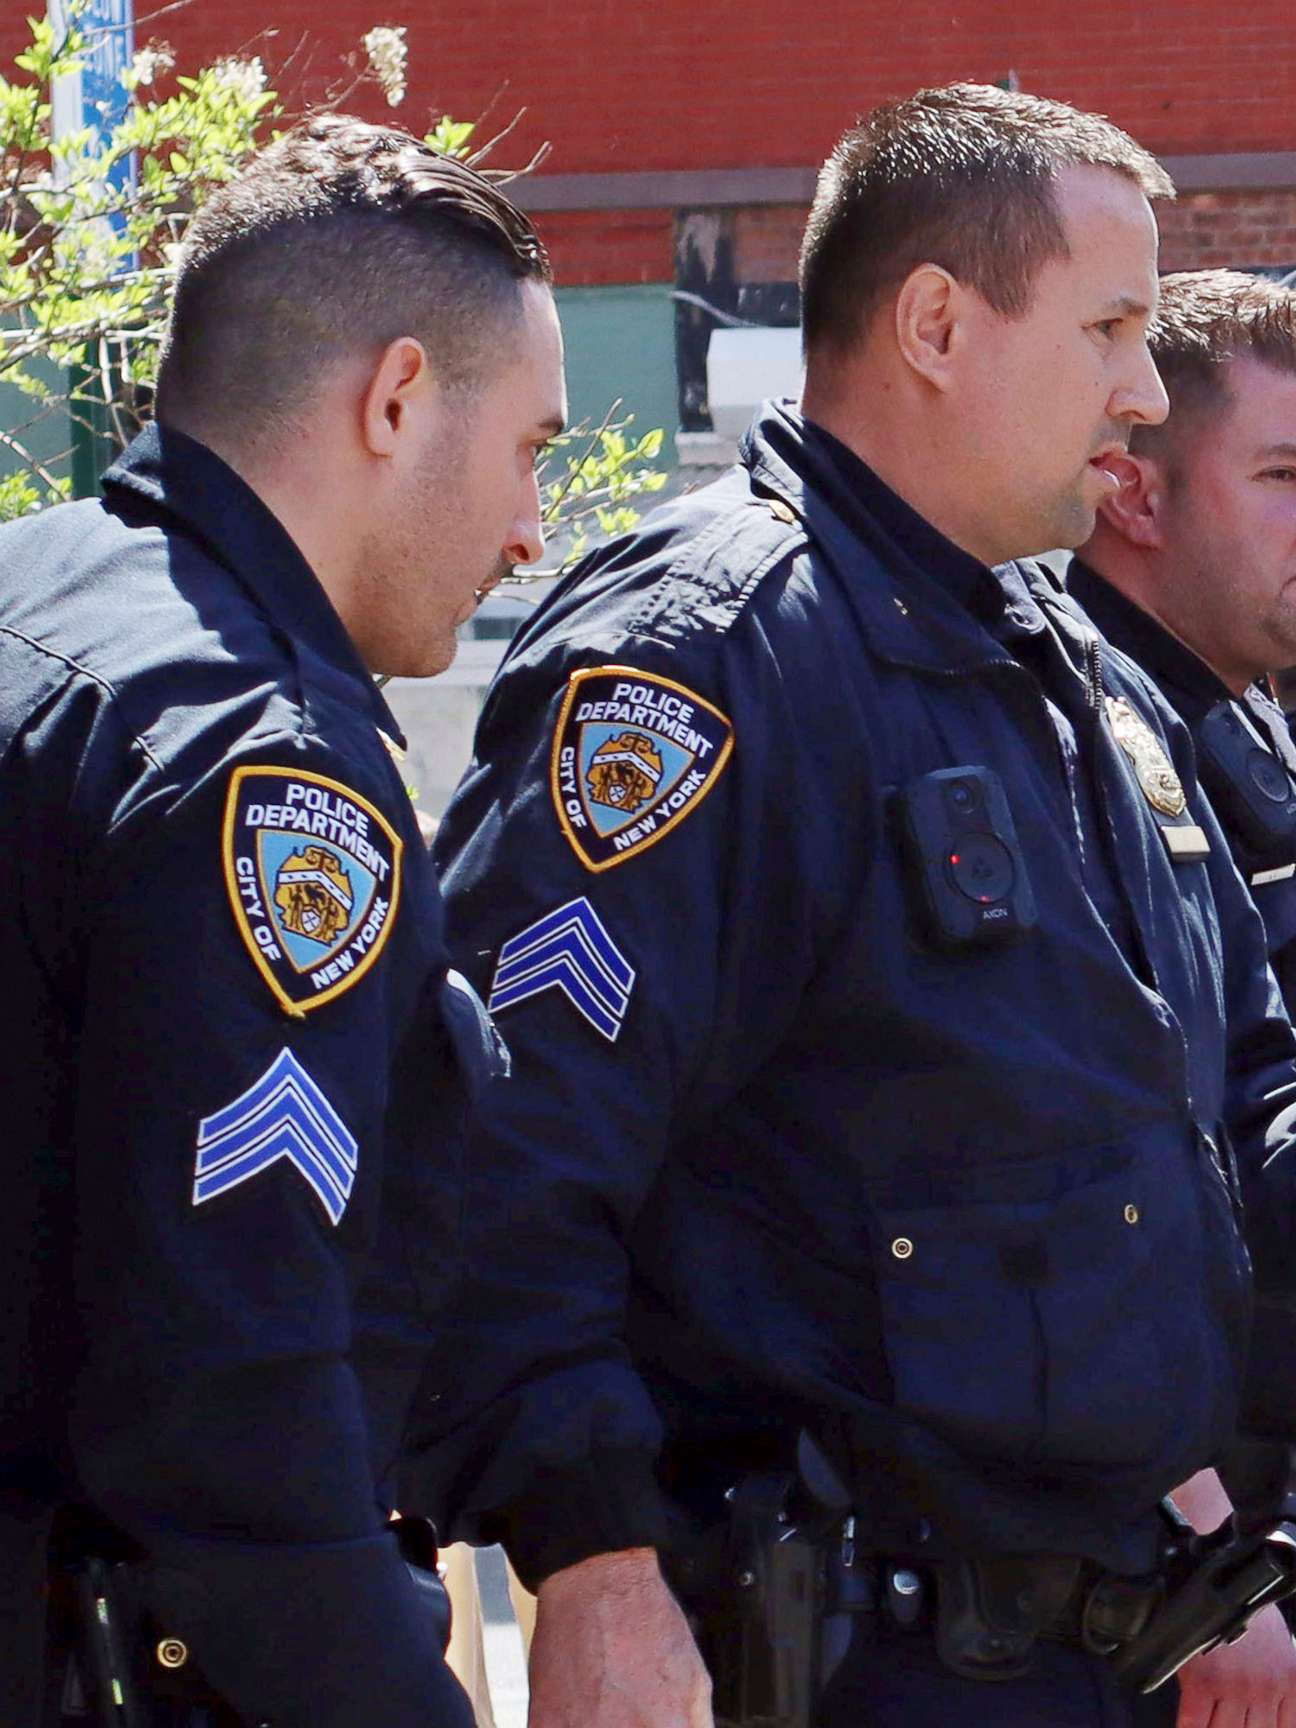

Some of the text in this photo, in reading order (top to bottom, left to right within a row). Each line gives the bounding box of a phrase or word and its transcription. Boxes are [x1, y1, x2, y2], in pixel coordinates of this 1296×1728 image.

[575, 702, 714, 758] DEPARTMENT
[612, 683, 695, 724] POLICE
[285, 784, 369, 837] POLICE
[559, 746, 587, 829] CITY OF
[612, 768, 707, 851] NEW YORK
[245, 804, 390, 882] DEPARTMENT
[236, 856, 282, 962] CITY OF
[311, 896, 390, 990] NEW YORK
